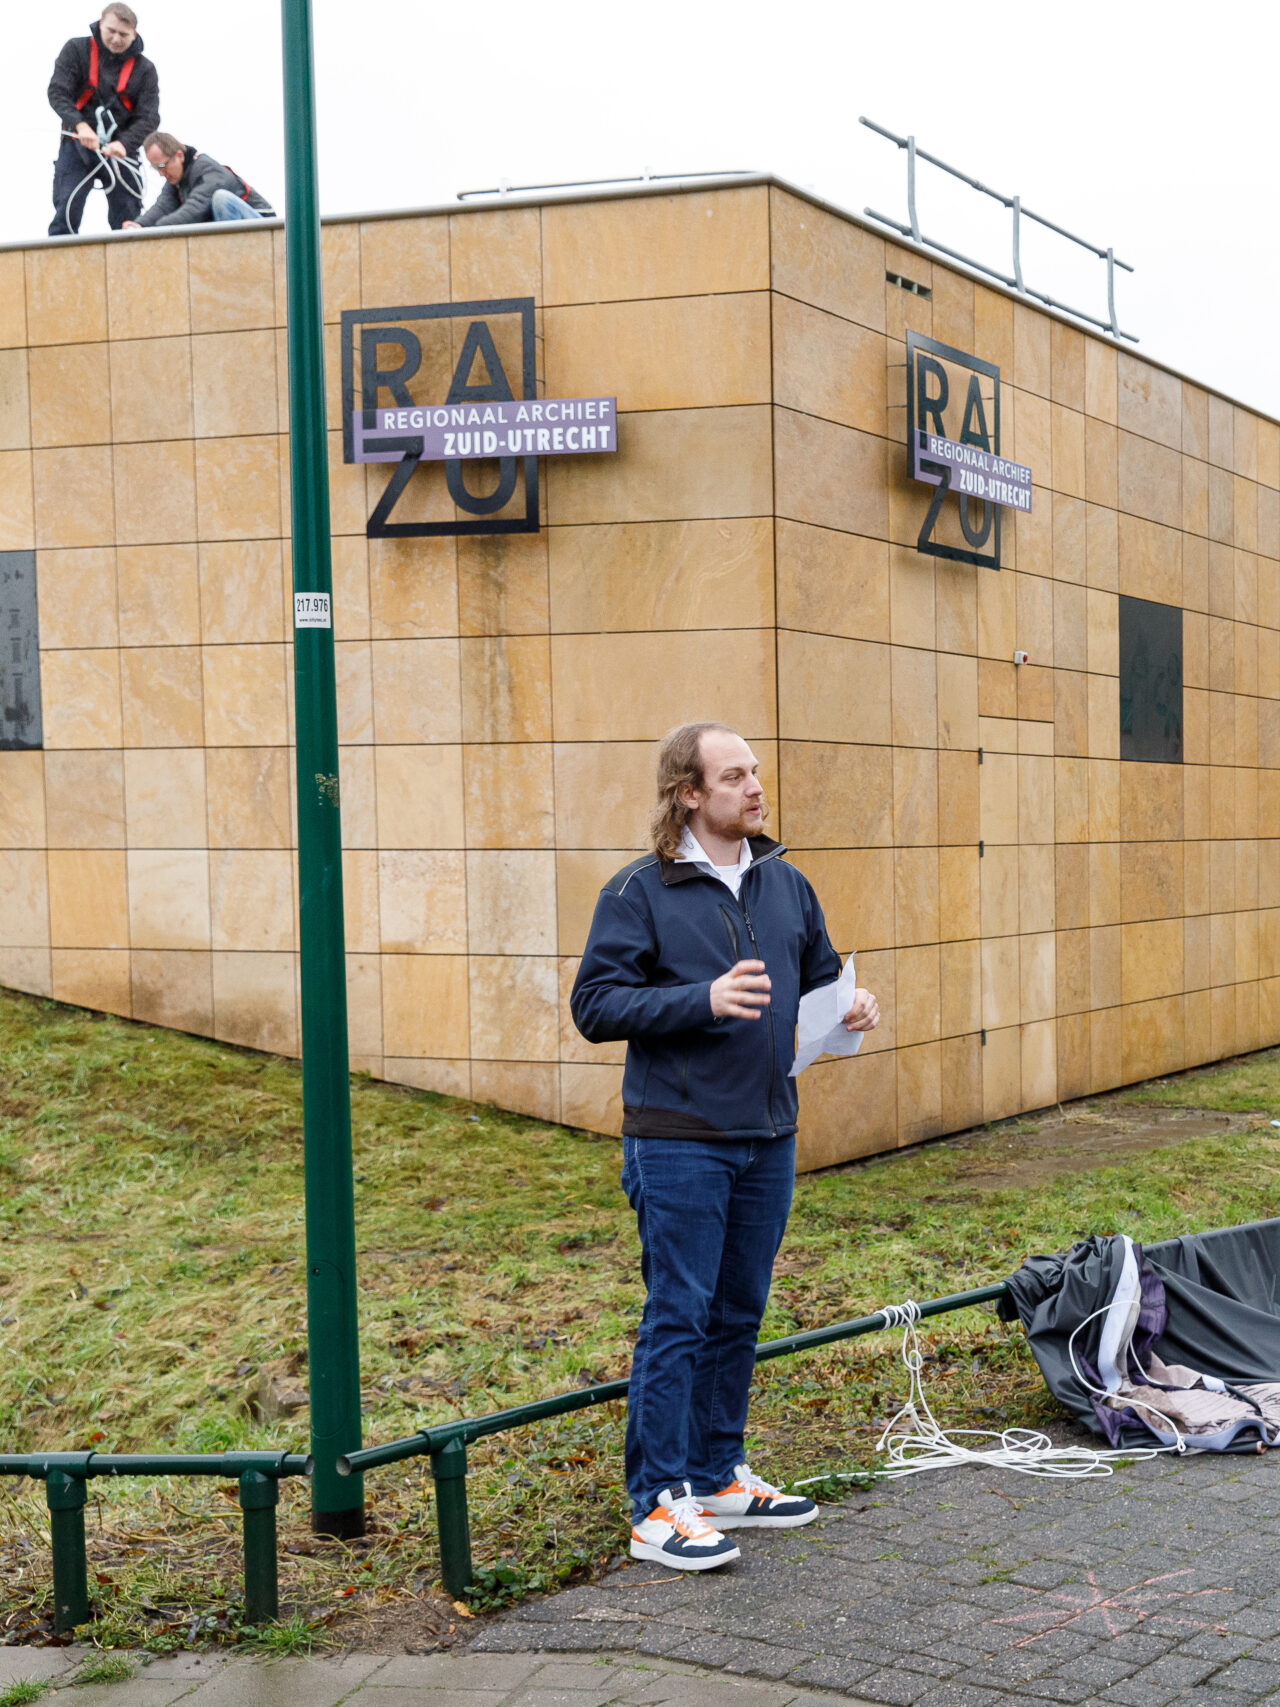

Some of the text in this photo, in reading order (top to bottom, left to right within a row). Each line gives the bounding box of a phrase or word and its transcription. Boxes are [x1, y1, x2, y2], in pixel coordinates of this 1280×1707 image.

[384, 401, 611, 430] REGIONAAL ARCHIEF
[443, 426, 611, 456] ZUID-UTRECHT
[930, 438, 1031, 484] REGIONAAL ARCHIEF
[959, 469, 1031, 510] ZUID-UTRECHT
[297, 599, 328, 612] 217.976
